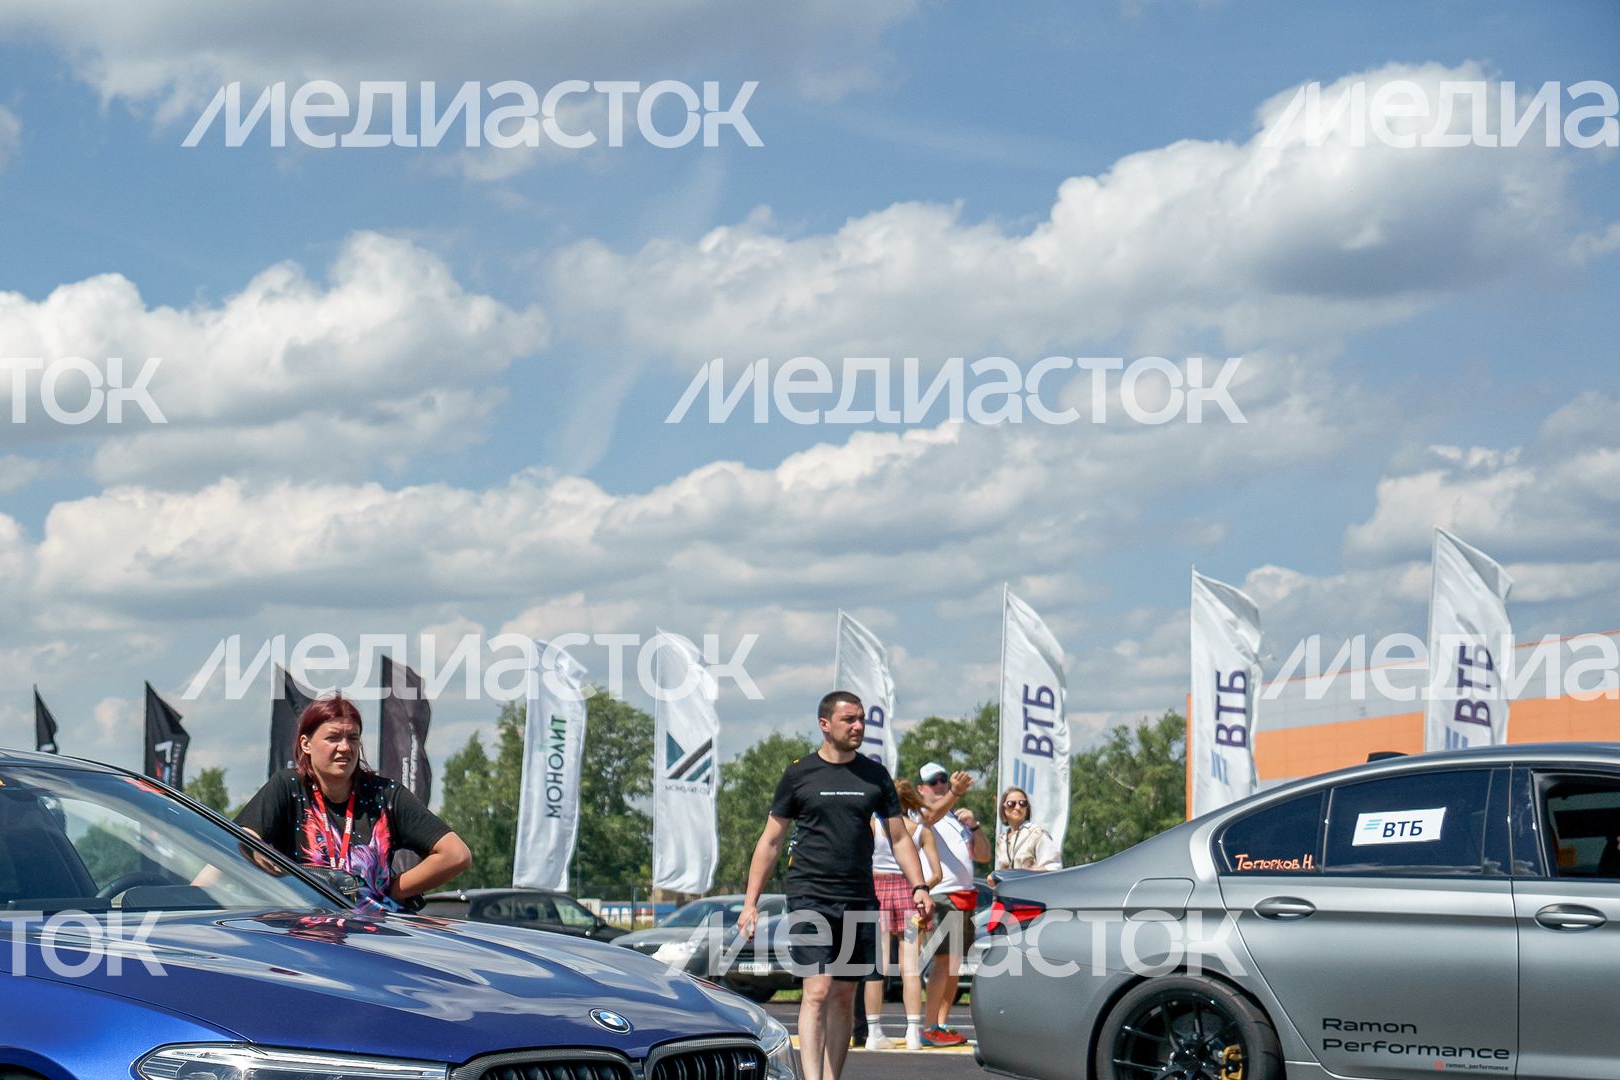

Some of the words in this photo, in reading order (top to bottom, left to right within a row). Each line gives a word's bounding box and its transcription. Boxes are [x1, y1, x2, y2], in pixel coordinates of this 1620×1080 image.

[1022, 684, 1055, 759] ВТБ
[1215, 669, 1247, 748] ВТБ
[1453, 641, 1494, 728] ВТБ
[545, 715, 567, 819] МОНОЛИТ
[1382, 819, 1424, 838] ВТБ
[1322, 1017, 1418, 1035] Ramon
[1322, 1037, 1511, 1060] Performance
